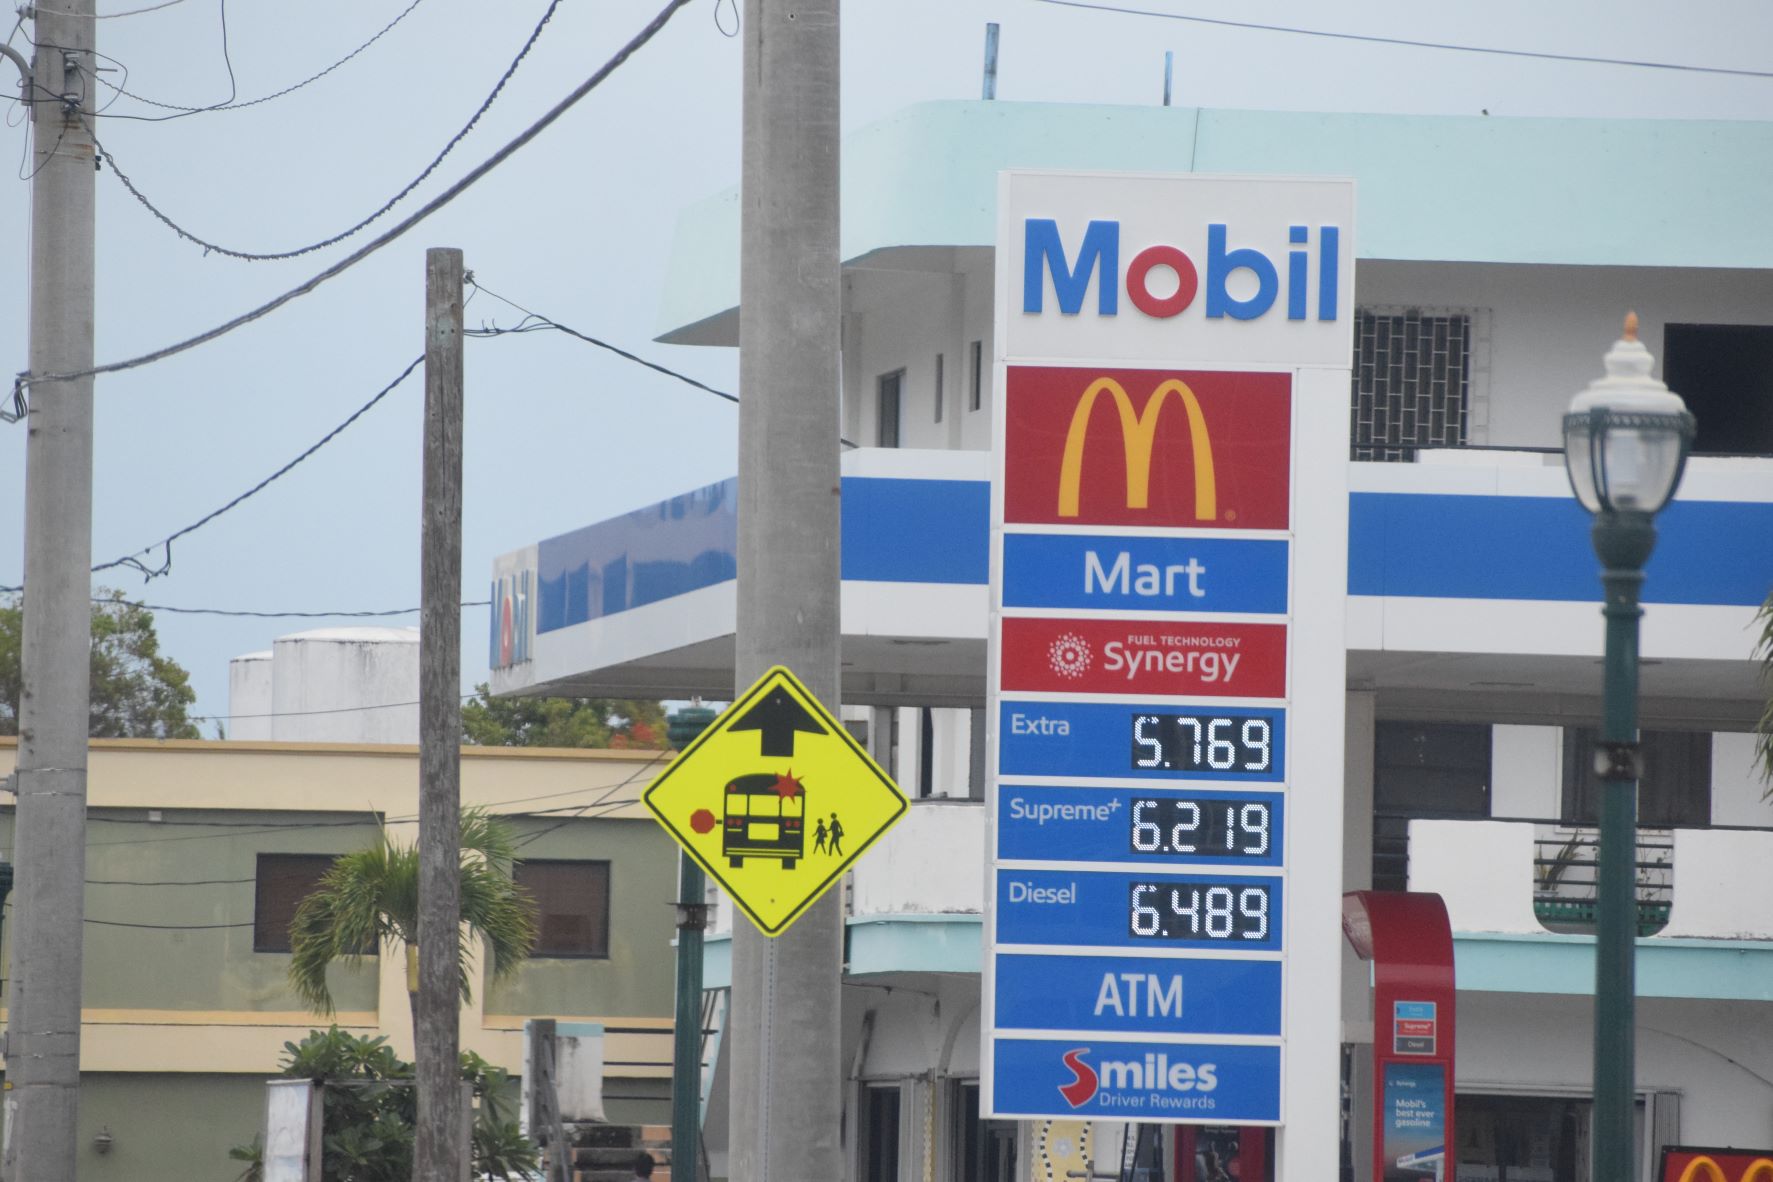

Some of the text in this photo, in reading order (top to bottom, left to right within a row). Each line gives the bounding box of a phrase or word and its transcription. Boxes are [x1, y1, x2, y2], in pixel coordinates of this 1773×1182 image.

[1023, 218, 1338, 321] Mobil
[1084, 551, 1206, 597] Mart
[1103, 641, 1240, 682] Synergy
[1128, 634, 1241, 648] FUEL TECHNOLOGY
[1011, 713, 1070, 736] Extra
[1134, 716, 1270, 771] 5.769
[1132, 800, 1269, 855] 6.219
[1009, 882, 1076, 904] Diesel
[1131, 884, 1268, 940] 6.489
[1094, 973, 1183, 1018] ATM
[1057, 1047, 1218, 1109] Smiles
[1099, 1092, 1216, 1109] Driver Rewards
[1395, 1099, 1426, 1108] Mobil's
[1395, 1108, 1435, 1118] best ever
[1395, 1118, 1431, 1128] gasoline
